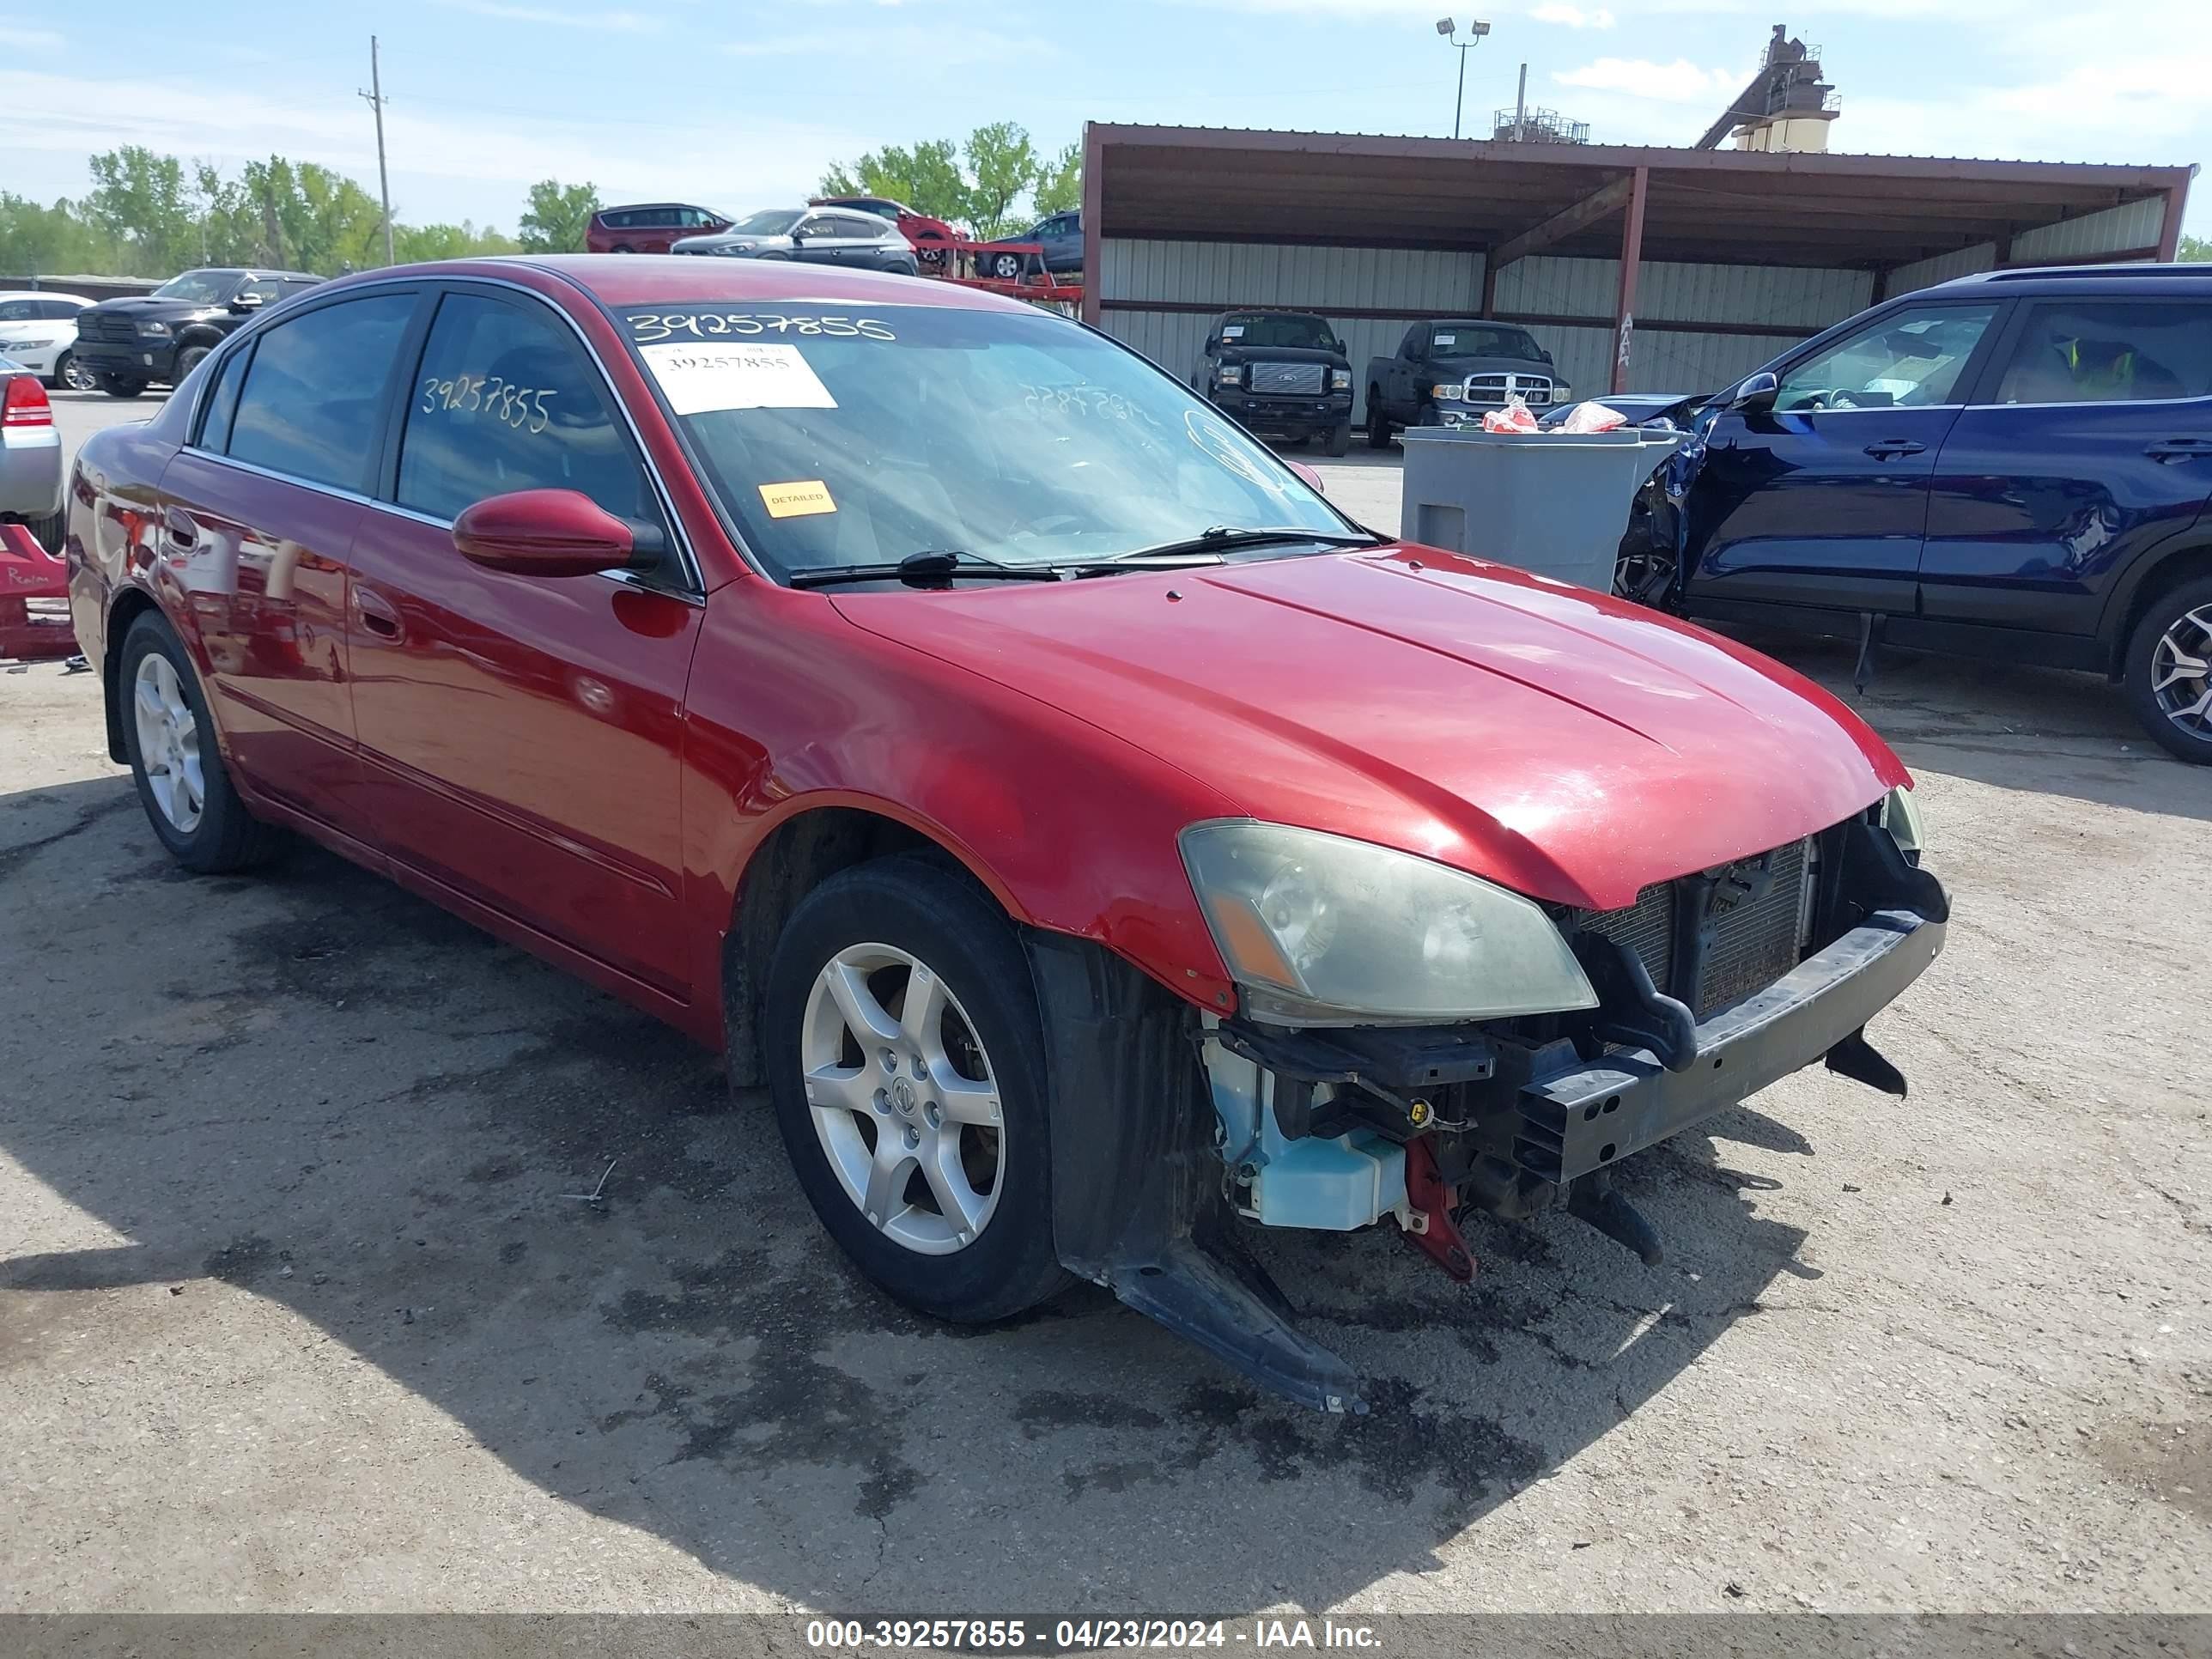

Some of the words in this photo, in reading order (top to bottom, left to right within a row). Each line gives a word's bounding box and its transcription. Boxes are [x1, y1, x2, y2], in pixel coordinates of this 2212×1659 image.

[627, 314, 896, 341] 39257855
[666, 356, 790, 371] 39257855
[422, 376, 558, 434] 39257855
[771, 494, 823, 504] DETAILED
